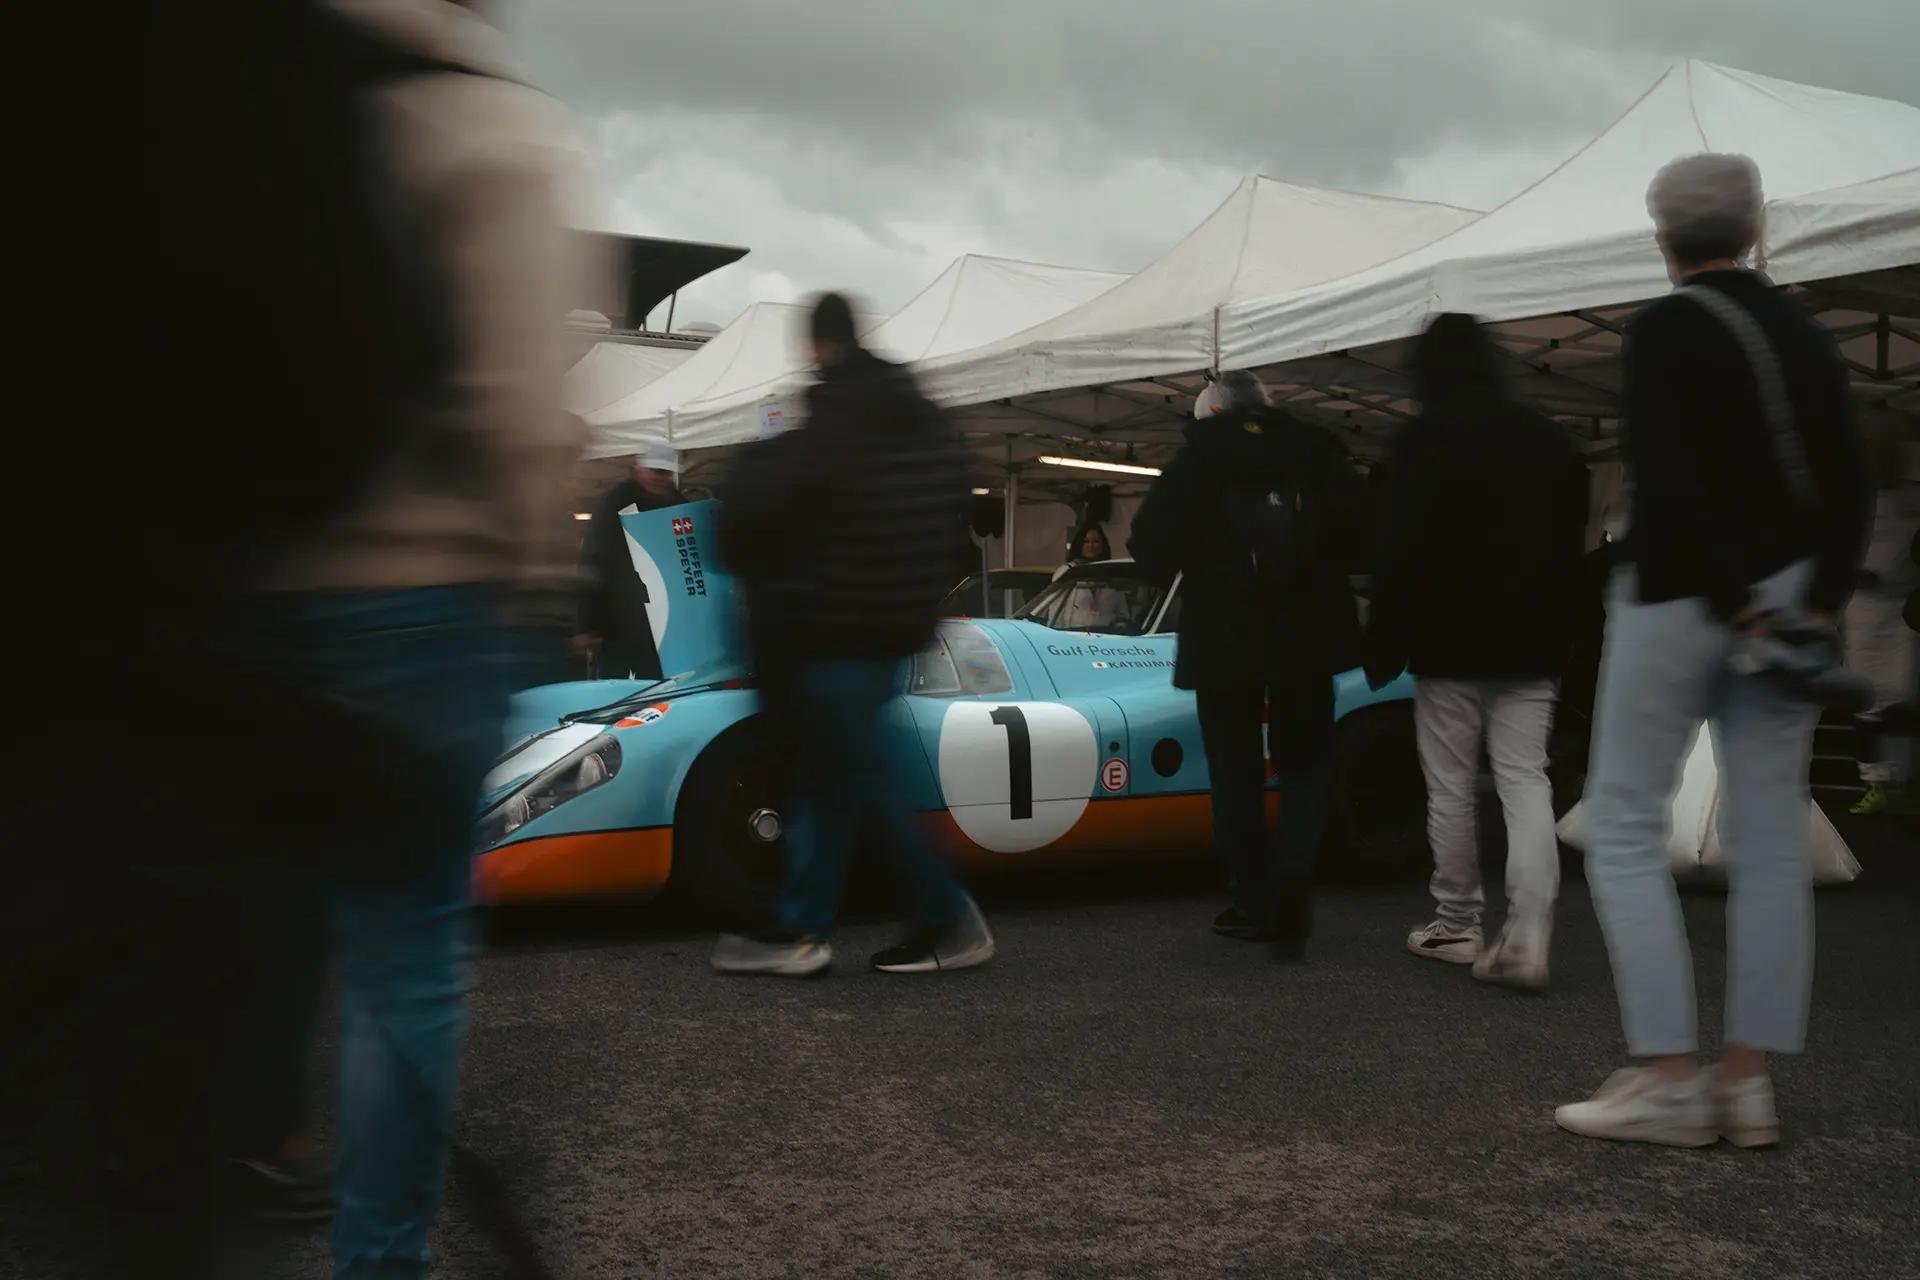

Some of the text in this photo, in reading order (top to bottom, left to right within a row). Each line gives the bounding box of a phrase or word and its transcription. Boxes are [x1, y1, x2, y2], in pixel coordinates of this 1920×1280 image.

[676, 538, 696, 596] SPEYER
[687, 536, 706, 597] SIFFERT
[1047, 644, 1156, 657] Gulf-Porsche
[1109, 660, 1177, 669] KATSUMA
[989, 705, 1032, 820] 1
[1109, 767, 1121, 786] E
